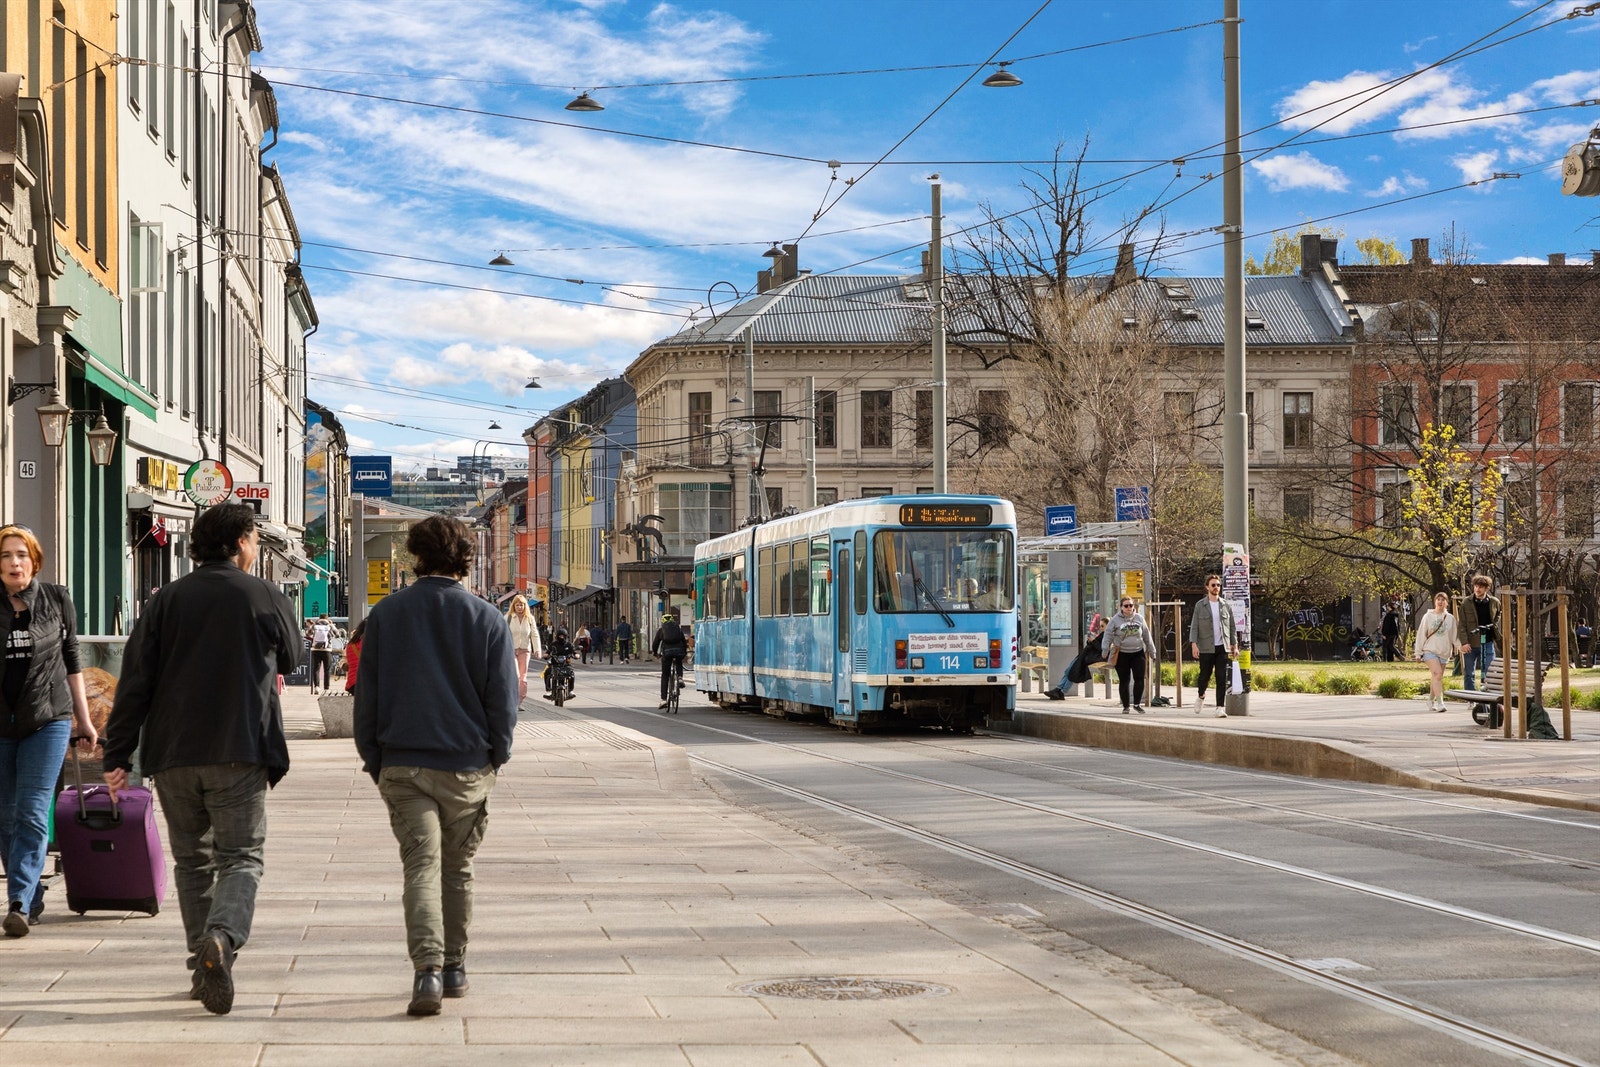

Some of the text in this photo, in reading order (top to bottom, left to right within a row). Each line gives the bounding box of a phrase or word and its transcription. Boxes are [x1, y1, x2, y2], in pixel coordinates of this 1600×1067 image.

[22, 463, 34, 476] 46
[234, 484, 269, 498] elna
[13, 630, 29, 638] the
[940, 655, 960, 670] 114
